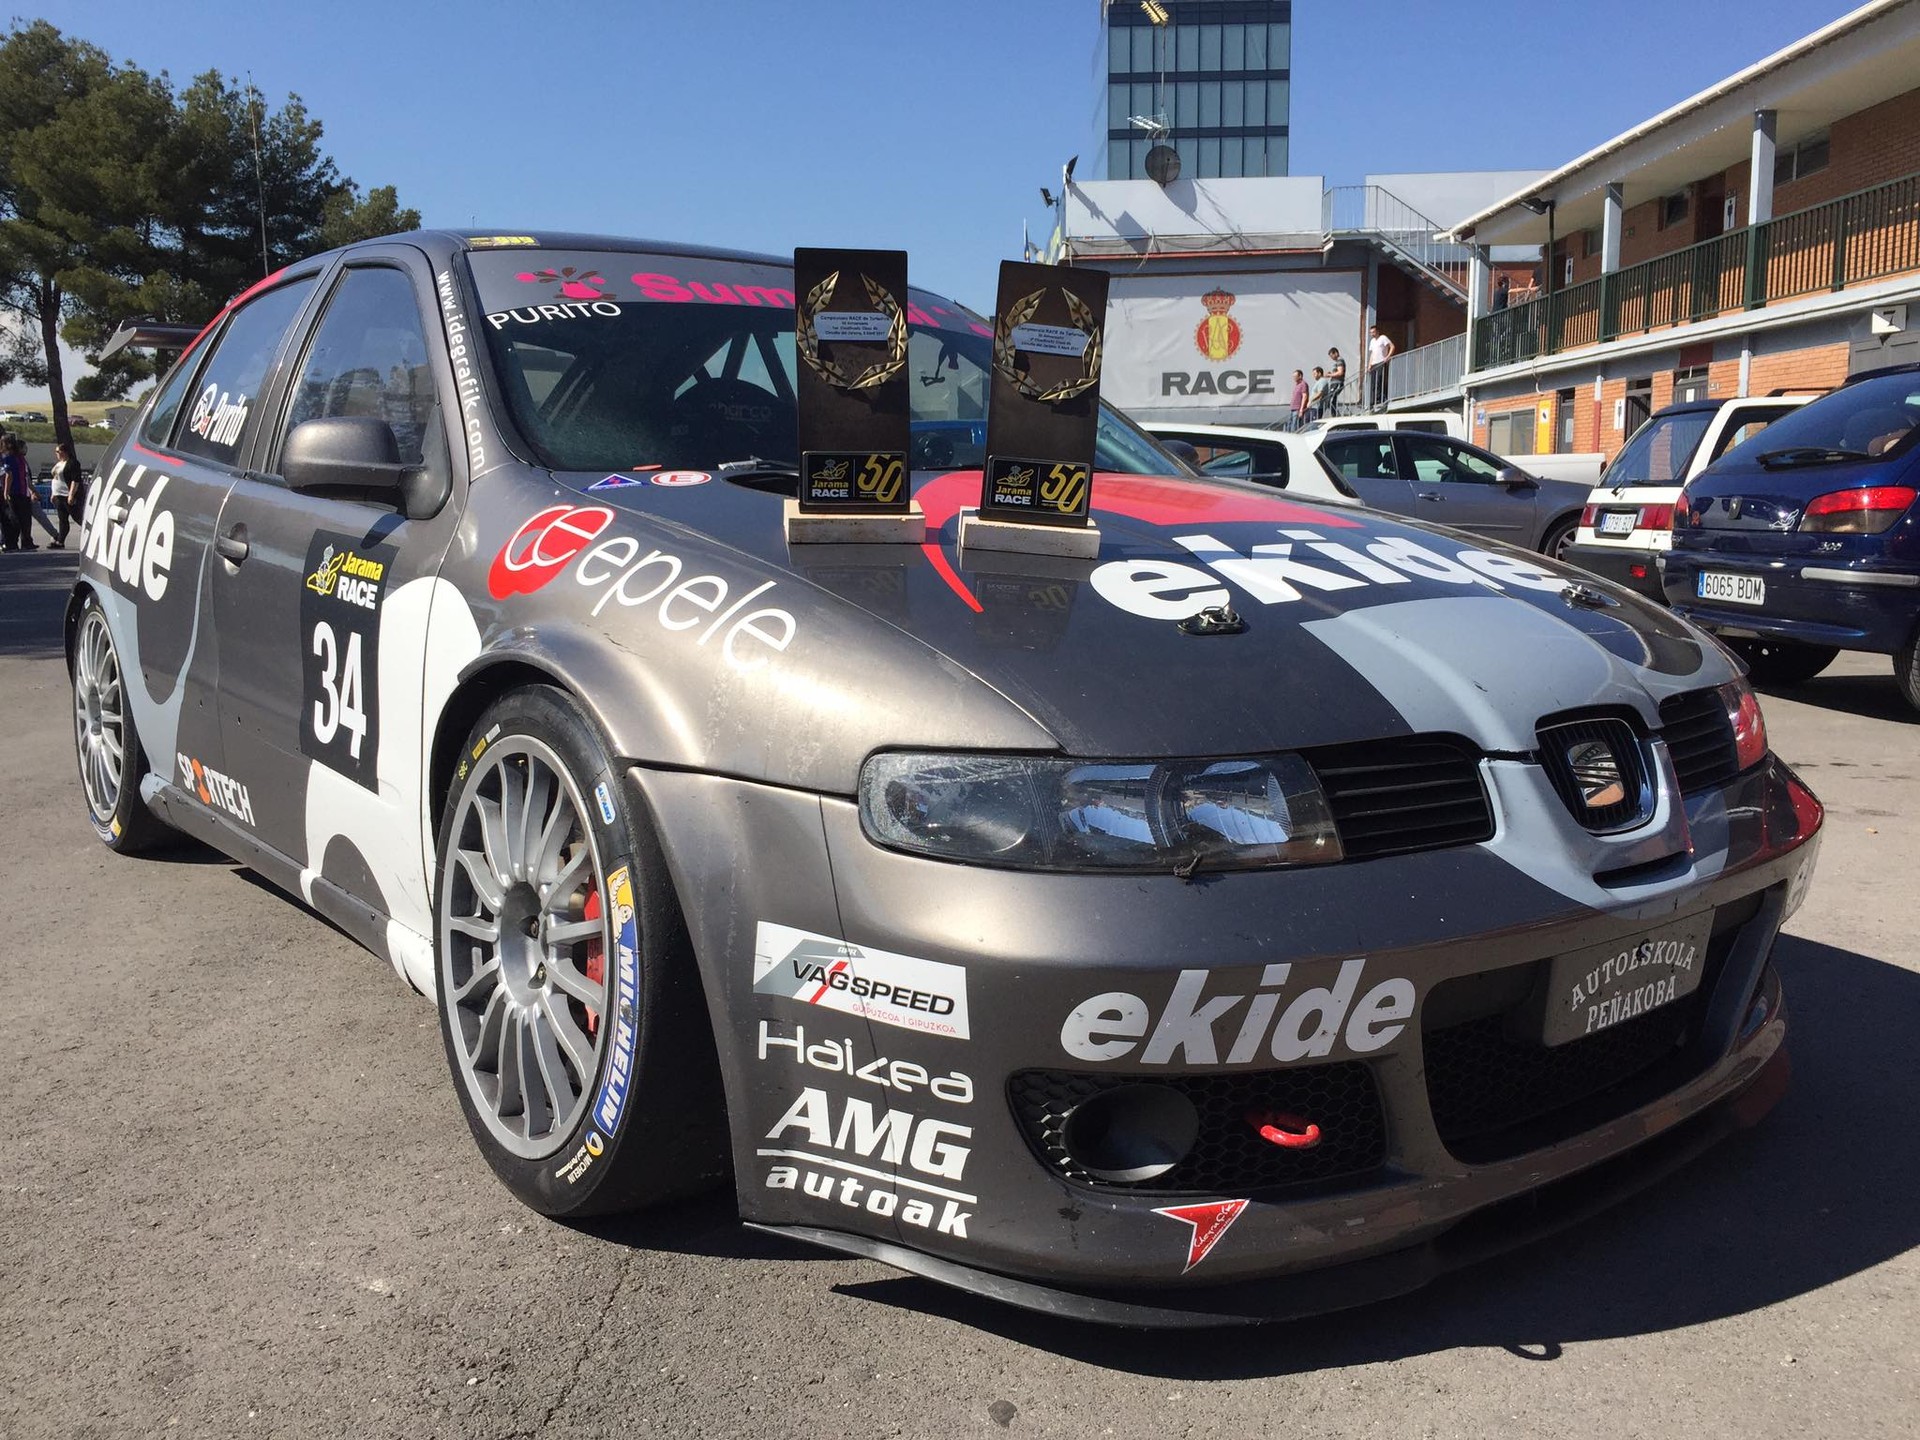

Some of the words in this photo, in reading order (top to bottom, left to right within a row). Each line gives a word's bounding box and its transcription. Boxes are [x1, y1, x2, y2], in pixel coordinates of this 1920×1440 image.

[486, 302, 622, 331] PURITO
[1883, 310, 1896, 326] 7
[438, 270, 485, 471] www.idegrafik.com
[1162, 369, 1275, 396] RACE
[203, 391, 248, 447] Purito
[812, 480, 849, 489] Jarama
[812, 489, 849, 498] RACE
[857, 454, 902, 502] 50
[994, 494, 1032, 505] RACE
[996, 485, 1032, 496] Jarama
[1040, 464, 1086, 513] 50
[80, 458, 175, 601] ekide
[341, 551, 384, 581] Jarama
[1090, 530, 1570, 620] ekide
[1705, 574, 1734, 597] 6065
[1737, 577, 1762, 600] BDM
[336, 575, 378, 610] RACE
[575, 536, 797, 673] epele
[313, 621, 367, 760] 34
[792, 959, 955, 1016] VAGSPEED
[1571, 941, 1696, 1012] AUTOESKOLA
[852, 1003, 901, 1023] GUIPUZCOA
[1060, 958, 1416, 1065] ekide
[1585, 975, 1677, 1034] PEÑAKOBA
[600, 943, 635, 1129] MICHELIN
[764, 1086, 973, 1181] AMG
[765, 1165, 973, 1239] autoak
